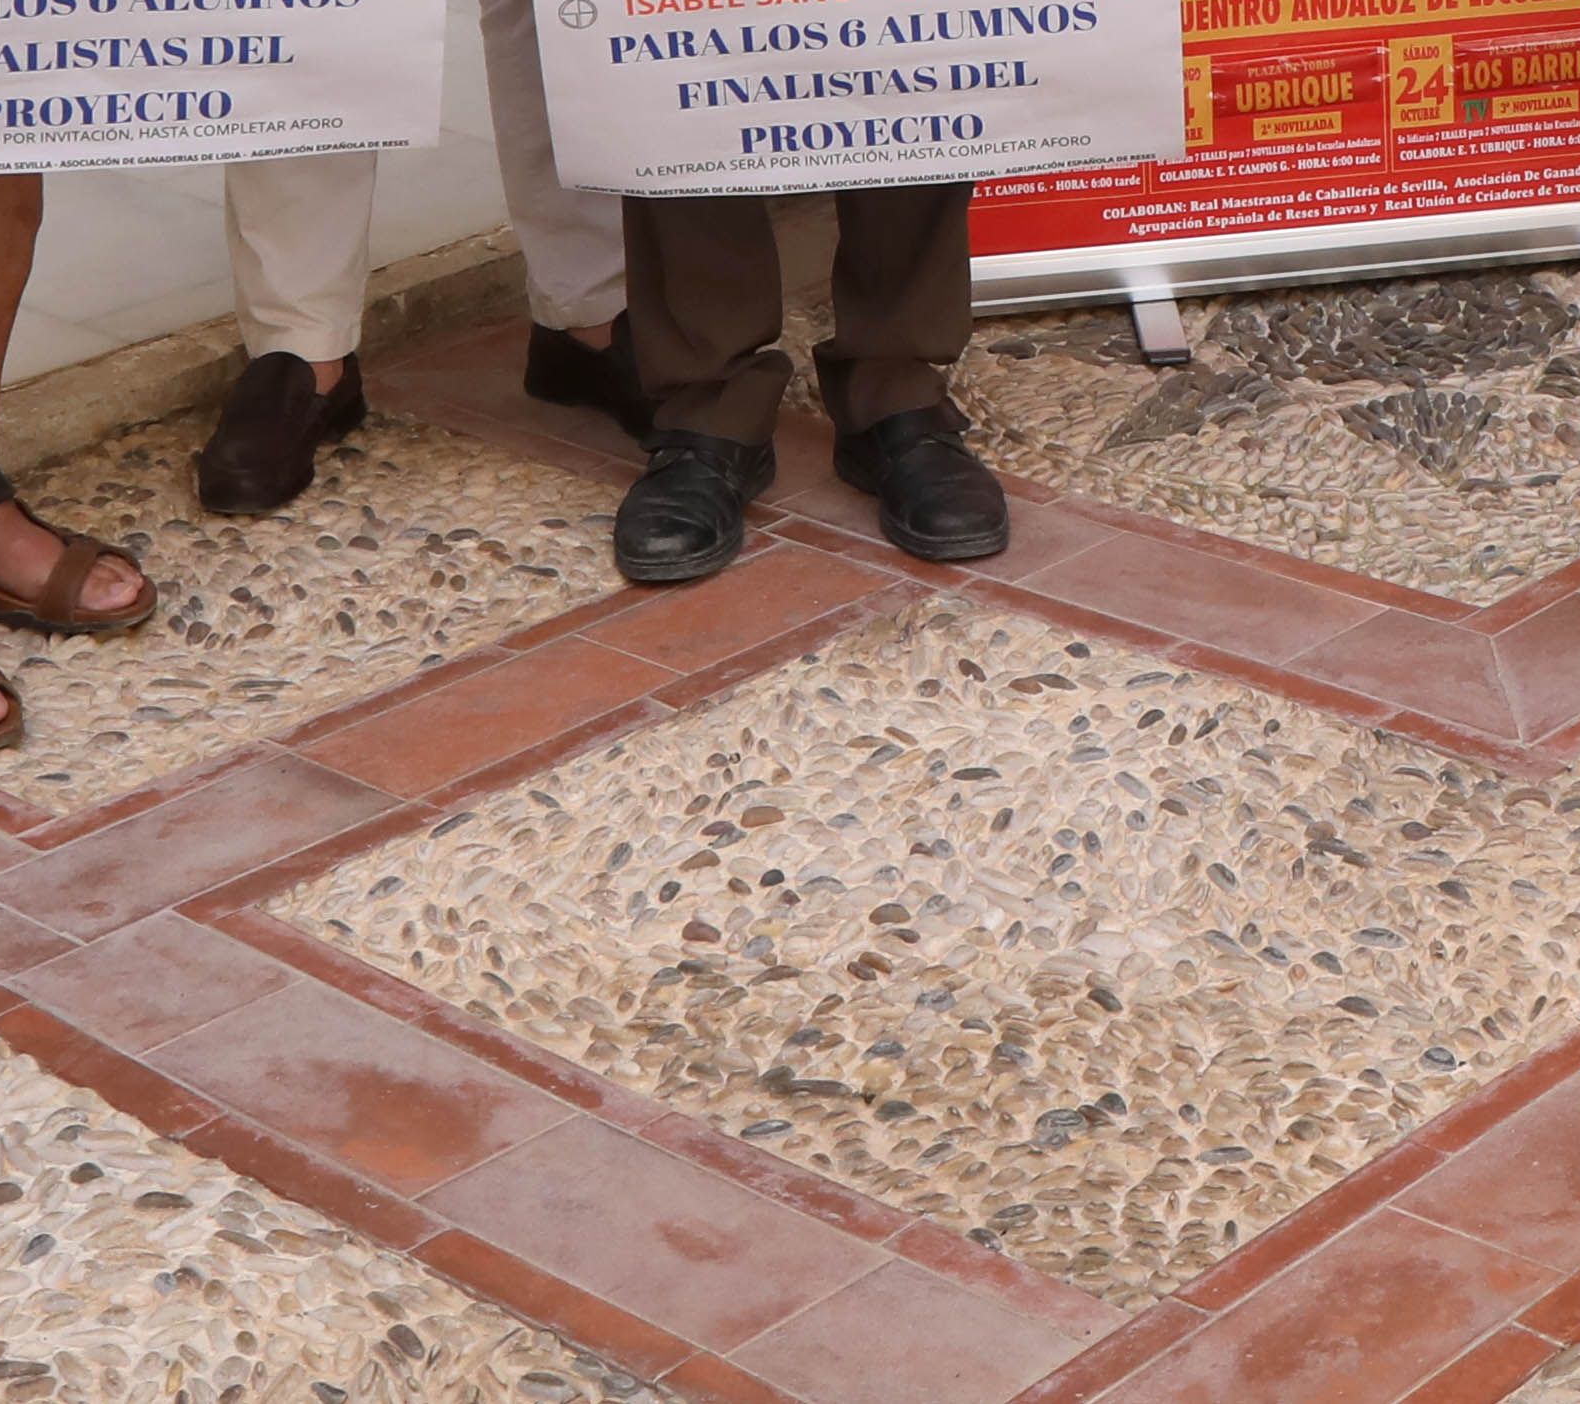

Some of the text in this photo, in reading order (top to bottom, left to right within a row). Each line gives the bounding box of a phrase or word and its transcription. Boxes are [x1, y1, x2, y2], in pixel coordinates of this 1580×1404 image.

[1103, 202, 1186, 220] COLABORAN:
[1190, 199, 1218, 212] Real
[1222, 194, 1294, 209] Maestranza
[1297, 191, 1312, 202] de
[1315, 184, 1380, 200] Caballería
[1383, 183, 1398, 194] de
[1401, 179, 1448, 193] Sevilla,
[1454, 171, 1521, 188] Asociación
[1524, 170, 1540, 181] De
